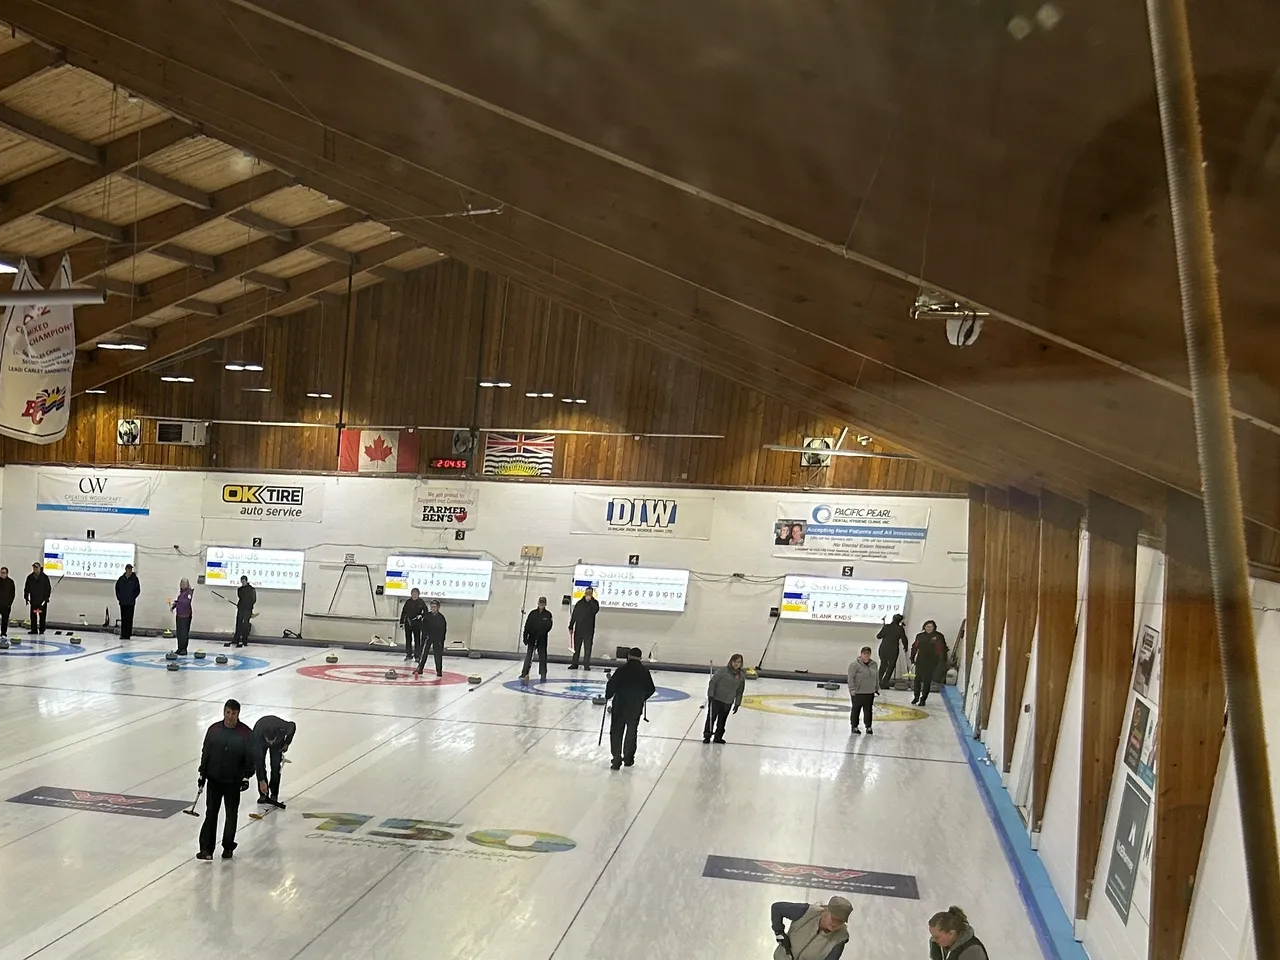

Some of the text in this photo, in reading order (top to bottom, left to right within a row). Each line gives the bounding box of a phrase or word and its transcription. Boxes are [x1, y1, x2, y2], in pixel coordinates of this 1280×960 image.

[223, 485, 301, 503] OK TIRE
[240, 506, 302, 517] auto service
[423, 506, 467, 514] FARMER
[608, 497, 677, 528] DIW
[834, 507, 892, 518] PACIFIC PEARL
[422, 514, 454, 523] BEN'S
[807, 527, 835, 535] Accepting
[849, 528, 872, 536] Patients
[302, 812, 577, 853] 150
